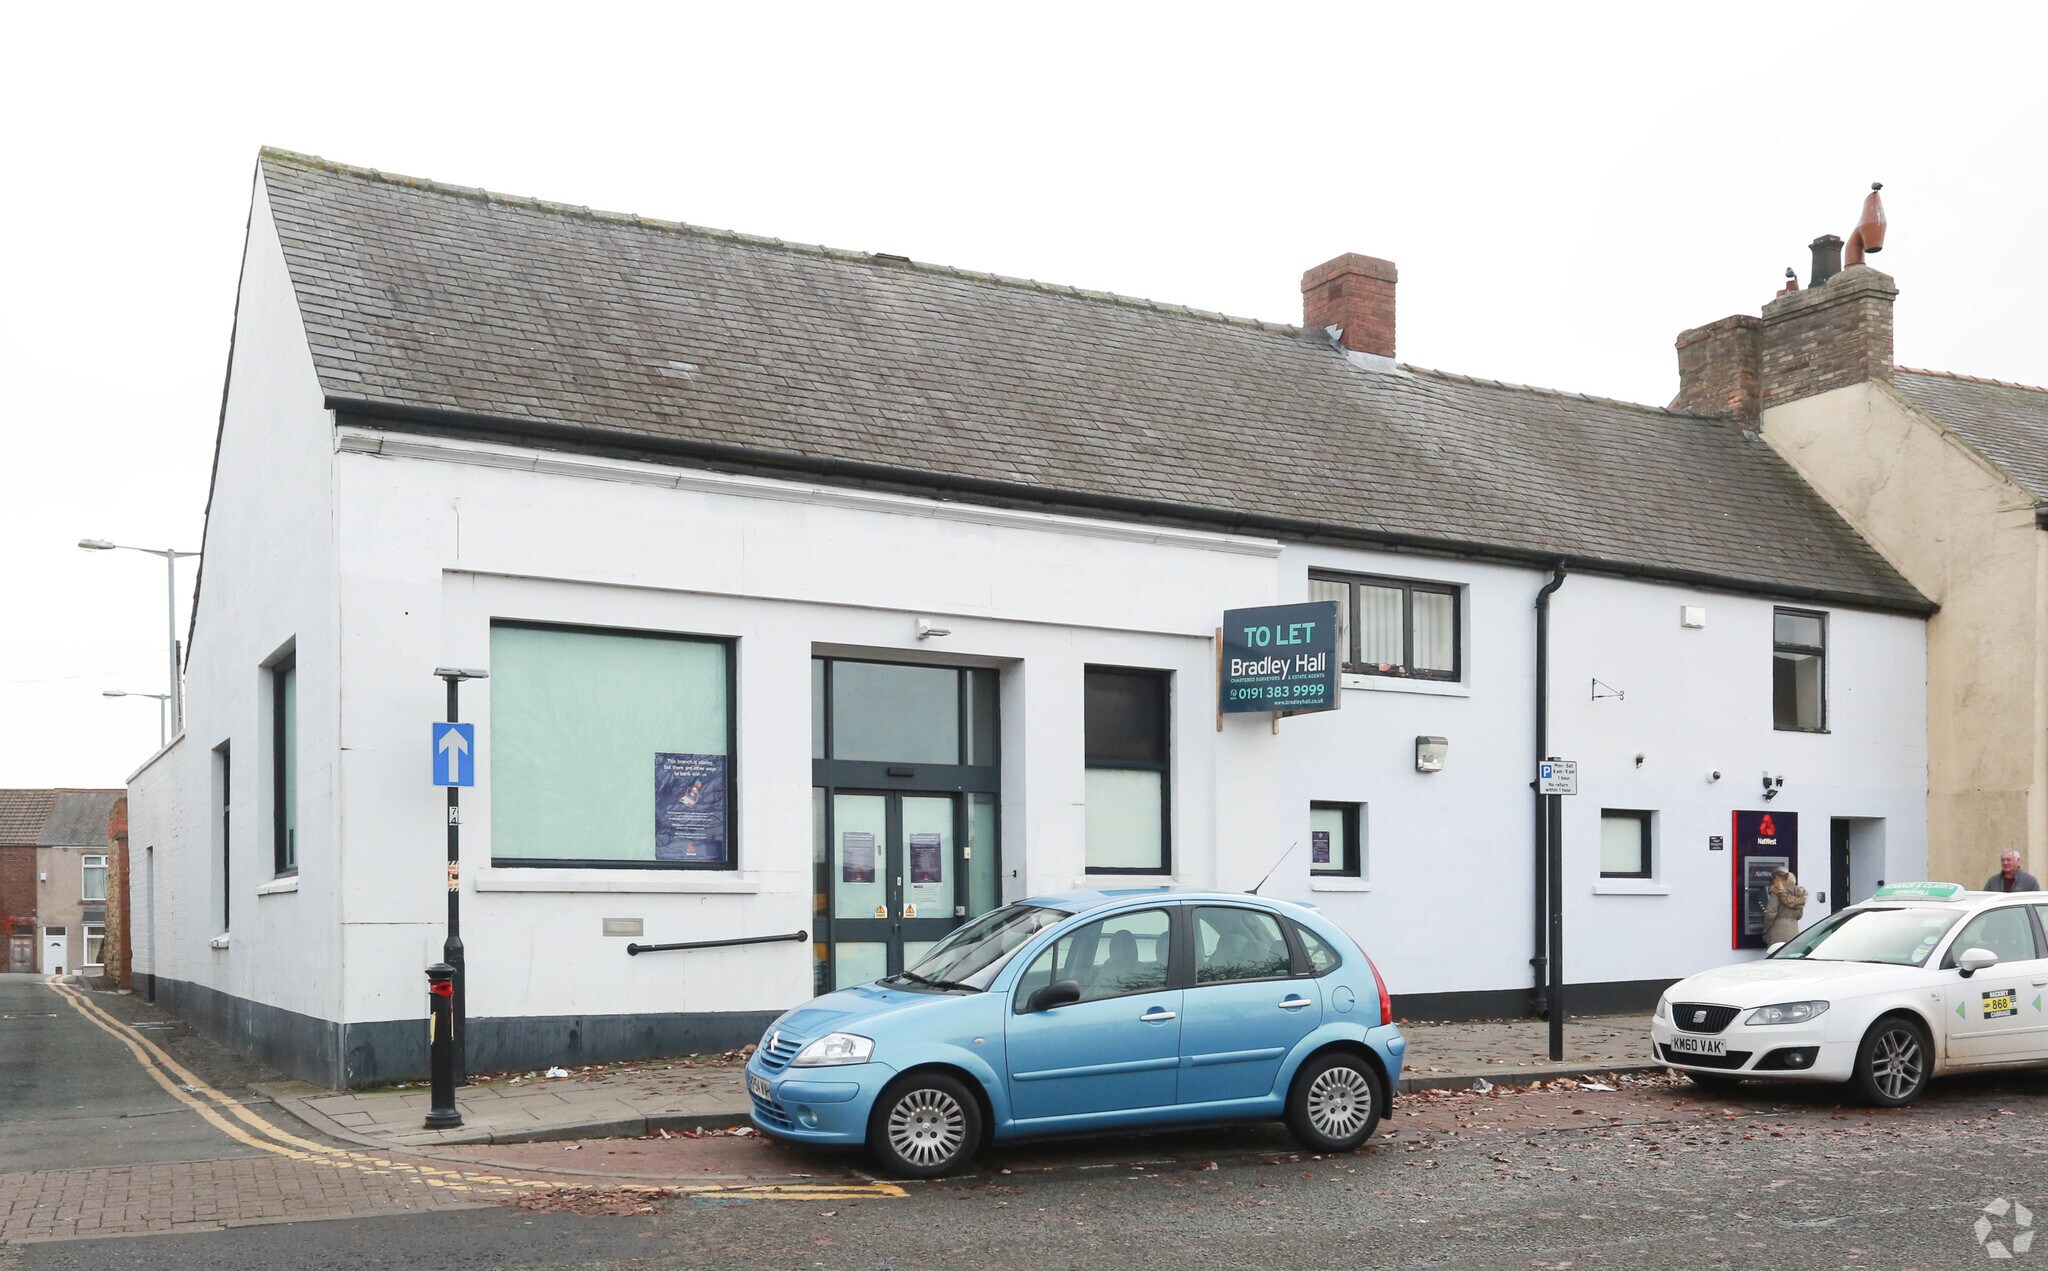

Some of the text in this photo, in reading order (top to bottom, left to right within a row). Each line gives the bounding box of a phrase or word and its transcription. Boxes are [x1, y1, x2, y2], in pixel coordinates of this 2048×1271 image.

[1244, 622, 1315, 648] TO LET
[1231, 652, 1326, 681] Bradley Hall
[1238, 684, 1325, 700] 0191 383 9999
[1274, 698, 1324, 706] www.bradleyhall.co.uk
[1543, 766, 1550, 777] P
[1757, 837, 1777, 845] NatWest
[1992, 998, 2008, 1010] 868
[1990, 1010, 2011, 1018] CARRIAGE
[1674, 1037, 1721, 1054] KM60 VAK
